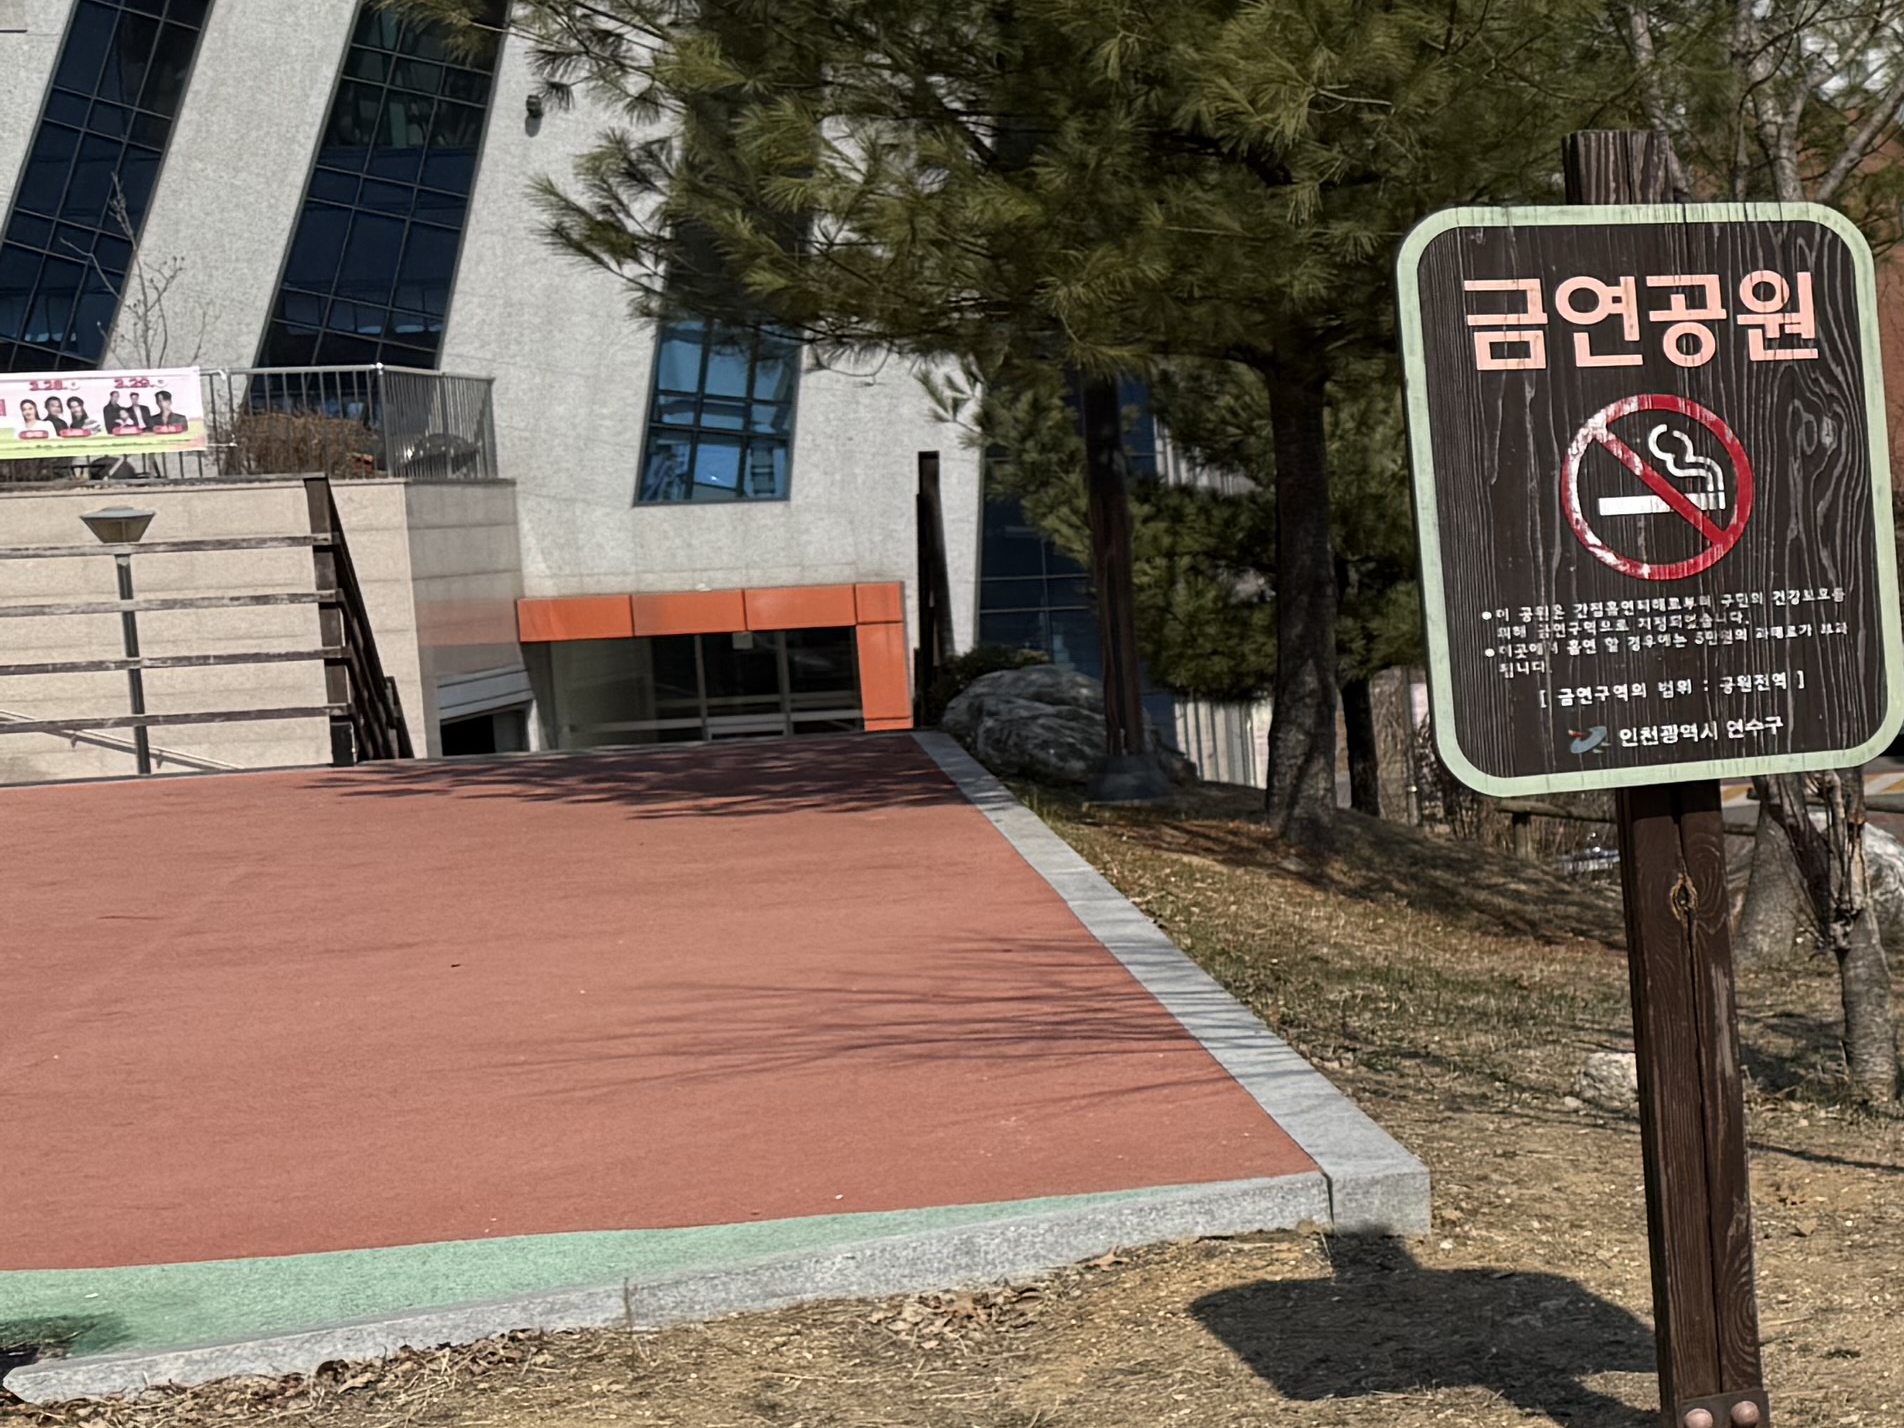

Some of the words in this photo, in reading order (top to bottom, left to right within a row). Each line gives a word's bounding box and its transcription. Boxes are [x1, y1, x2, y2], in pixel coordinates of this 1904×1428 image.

[1462, 269, 1820, 372] 금연공원
[1495, 608, 1510, 622] 이
[1537, 618, 1630, 639] 금연구역으로
[1566, 637, 1597, 656] 흡연
[1627, 632, 1687, 652] 경우에는
[1658, 679, 1693, 699] 범위
[1619, 720, 1719, 748] 인천광역시
[1726, 715, 1784, 739] 연수구
